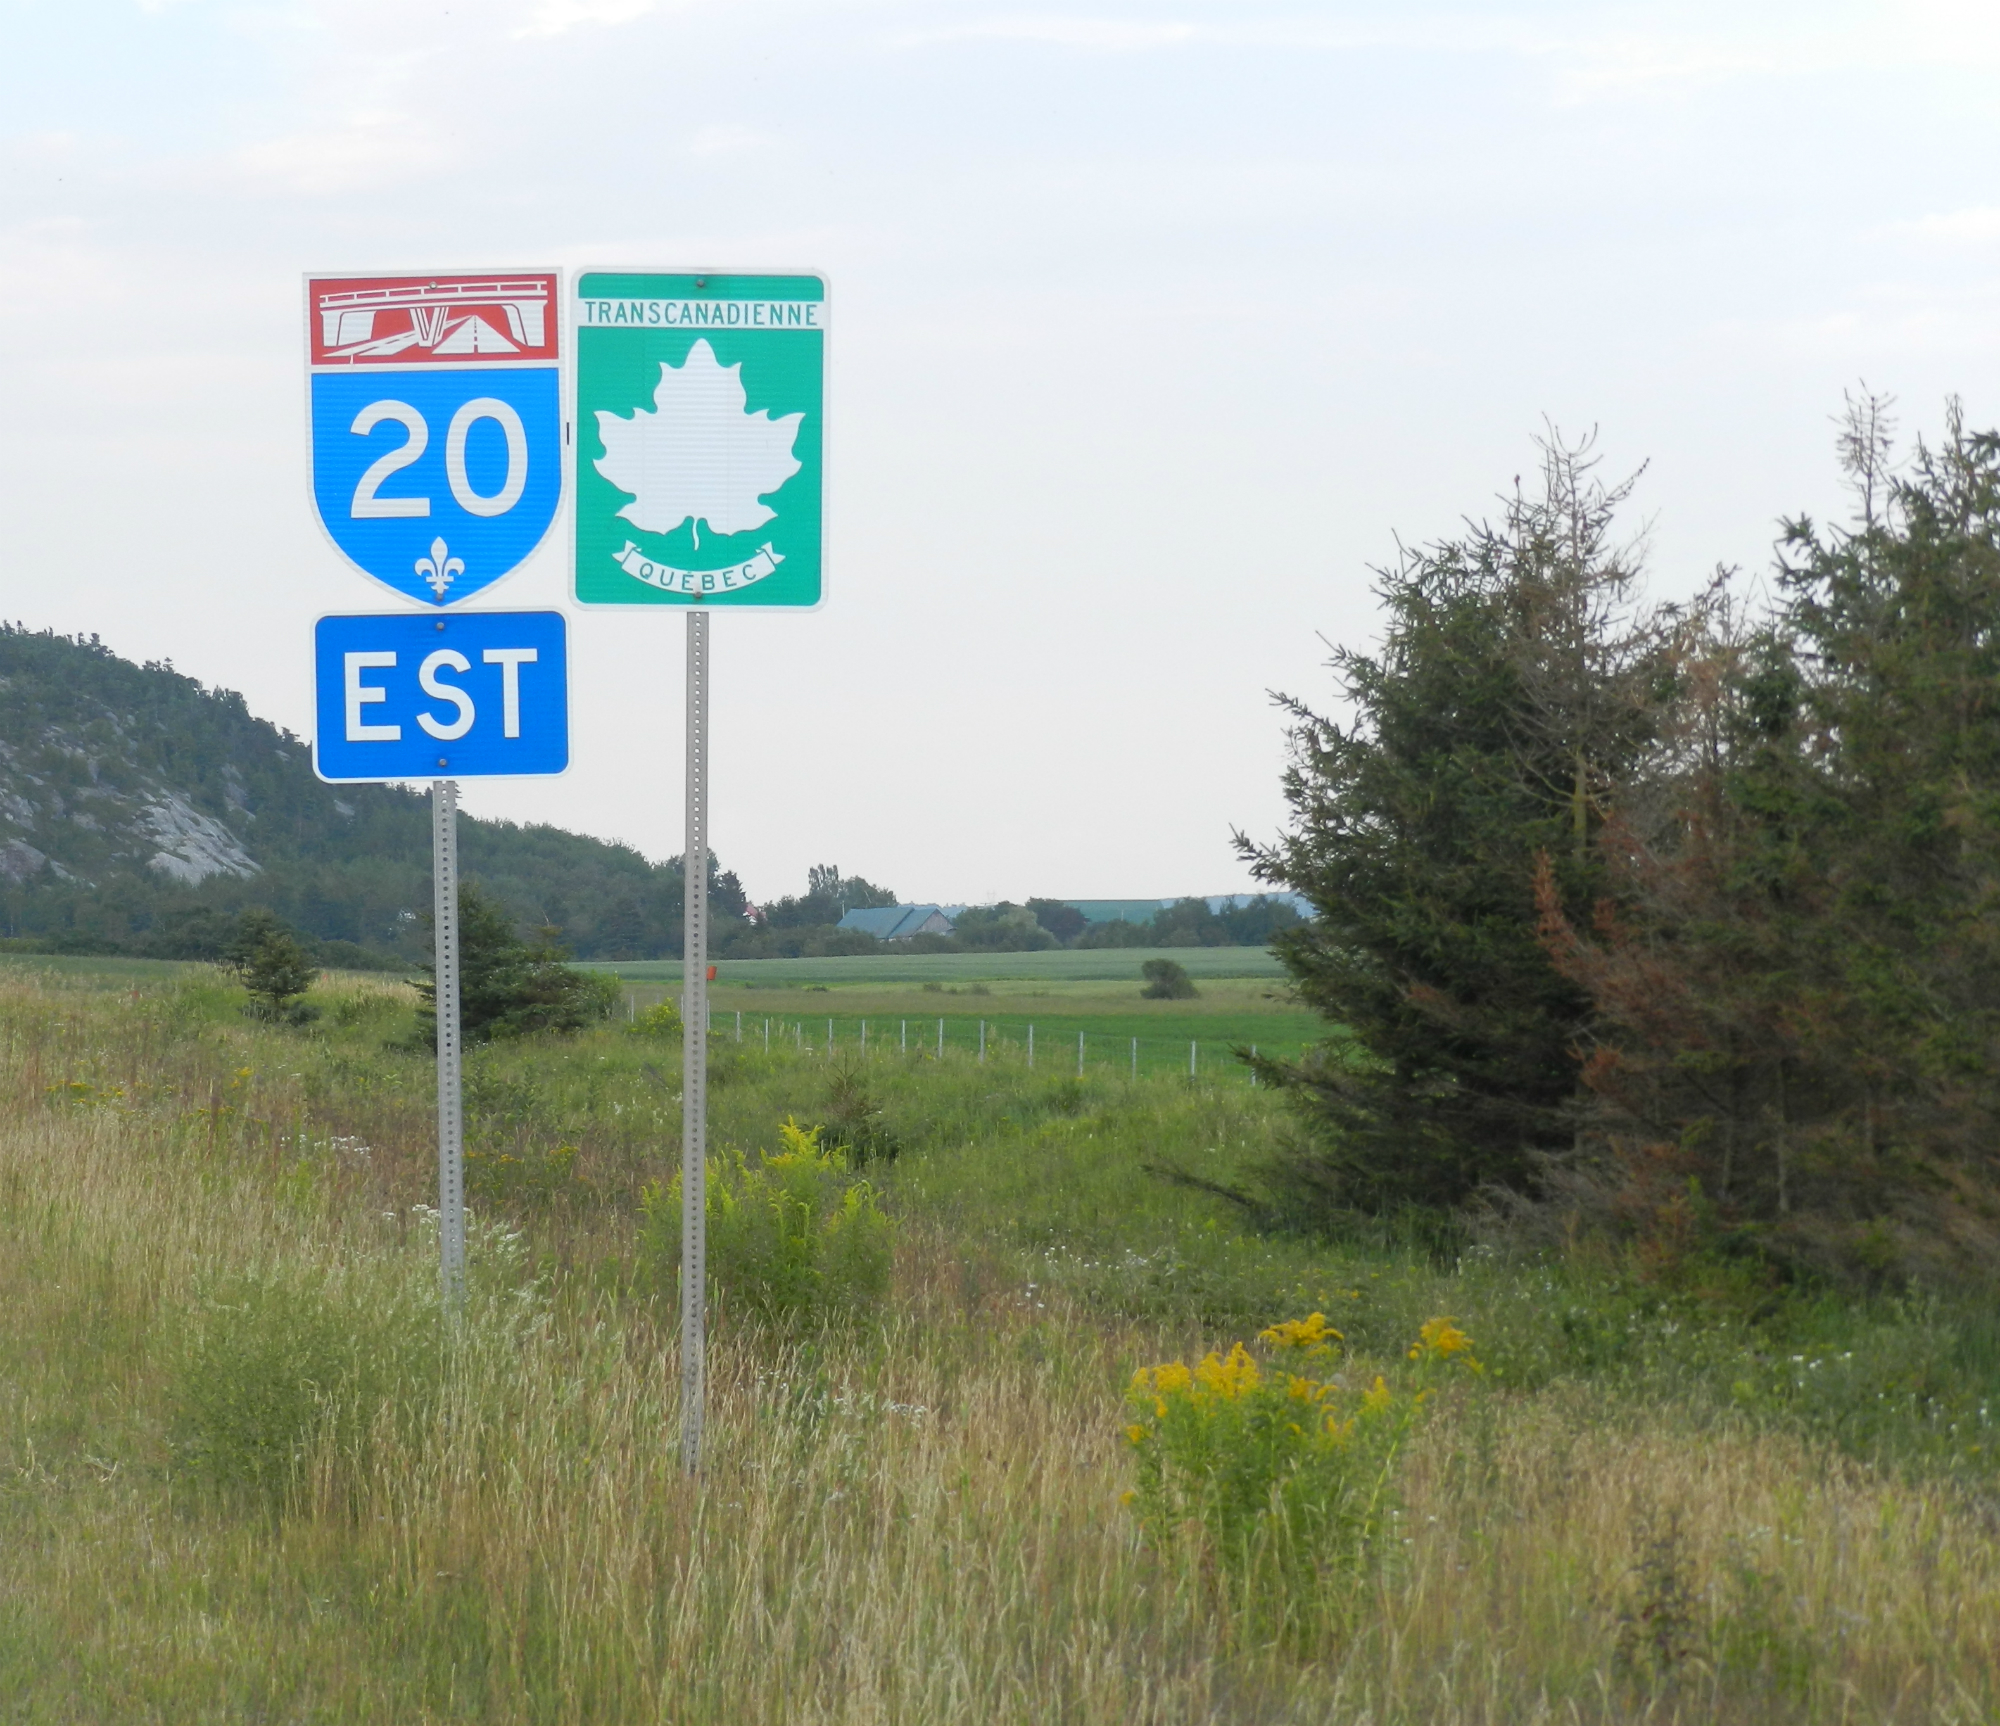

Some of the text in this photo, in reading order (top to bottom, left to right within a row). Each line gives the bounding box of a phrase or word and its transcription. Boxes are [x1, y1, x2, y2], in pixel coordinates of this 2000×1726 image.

[585, 301, 817, 326] TRANSCANADIENNE
[350, 397, 528, 519] 20
[639, 562, 757, 591] QUÉBEC
[343, 647, 538, 742] EST
